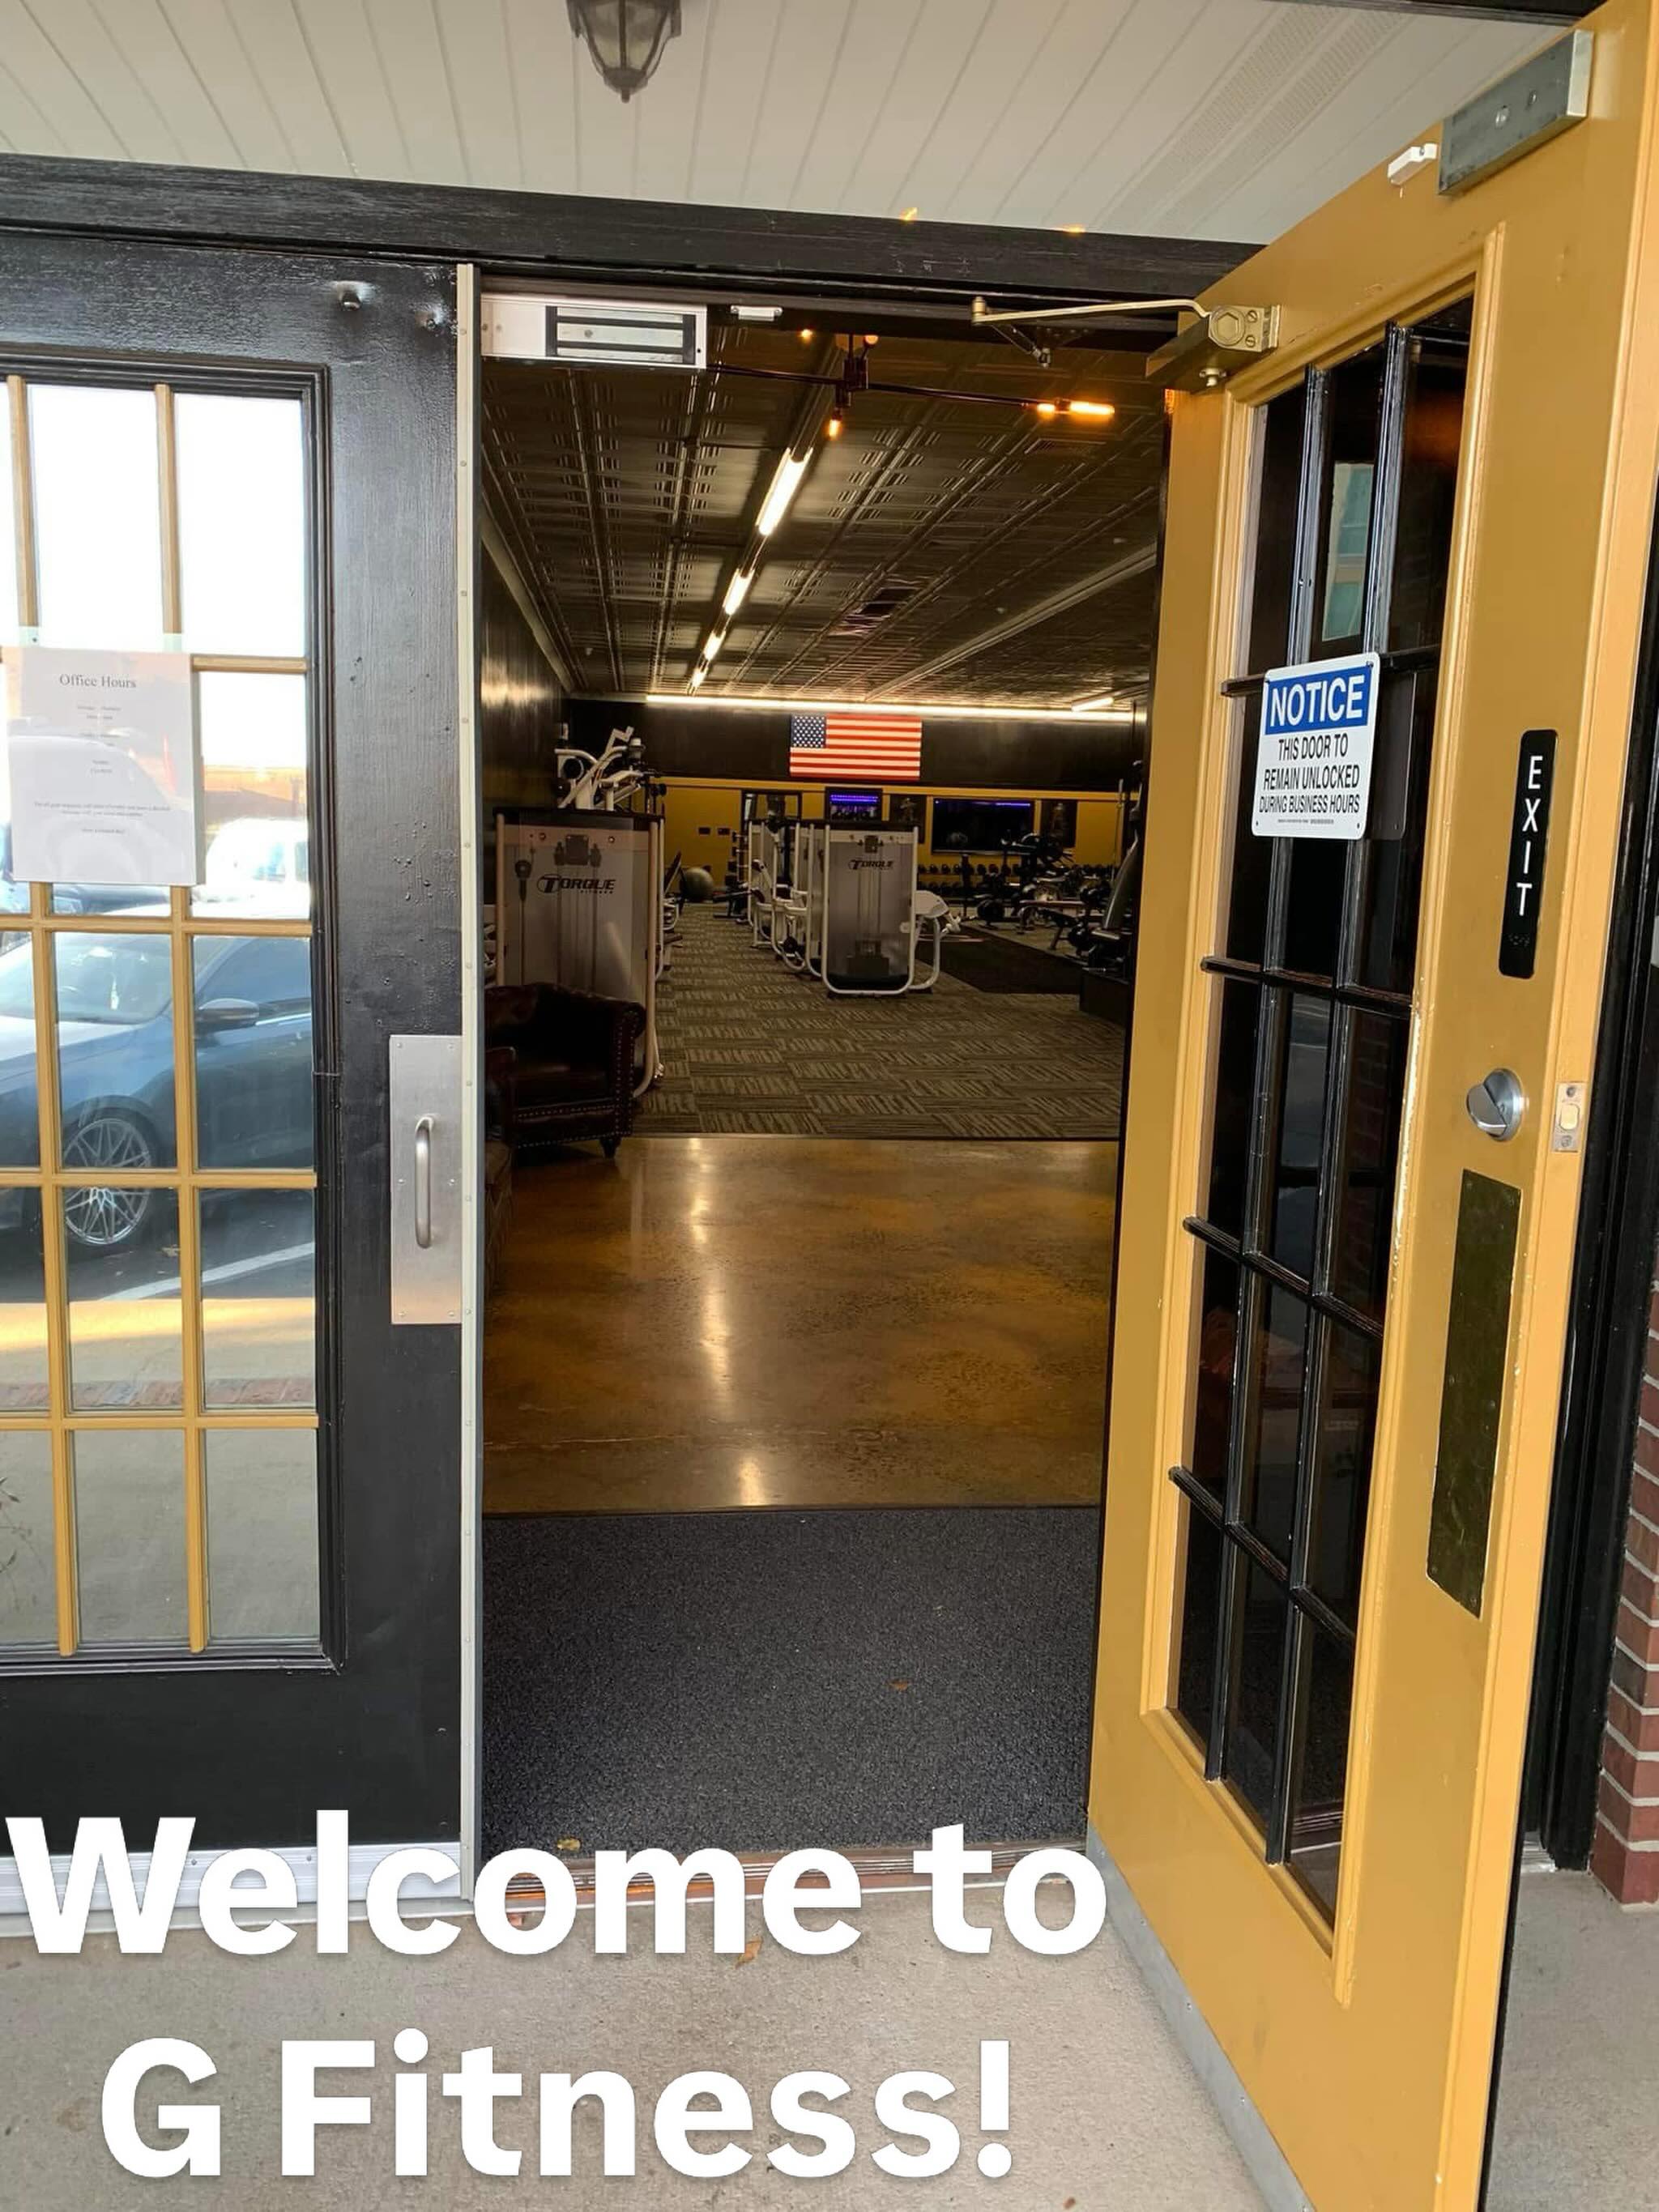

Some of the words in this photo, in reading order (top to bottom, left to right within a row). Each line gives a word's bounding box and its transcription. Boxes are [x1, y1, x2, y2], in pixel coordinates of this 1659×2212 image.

[59, 673, 97, 687] Office
[101, 676, 137, 688] Hours
[1270, 675, 1365, 727] NOTICE
[1278, 736, 1299, 761] THIS
[1301, 734, 1332, 759] DOOR
[1334, 732, 1349, 757] TO
[1264, 767, 1299, 790] REMAIN
[1302, 764, 1360, 789] UNLOCKED
[1259, 795, 1287, 813] DURING
[1289, 795, 1329, 813] BUSINESS
[1330, 794, 1360, 813] HOURS
[1516, 756, 1543, 916] EXIT
[538, 875, 616, 893] TORQUE
